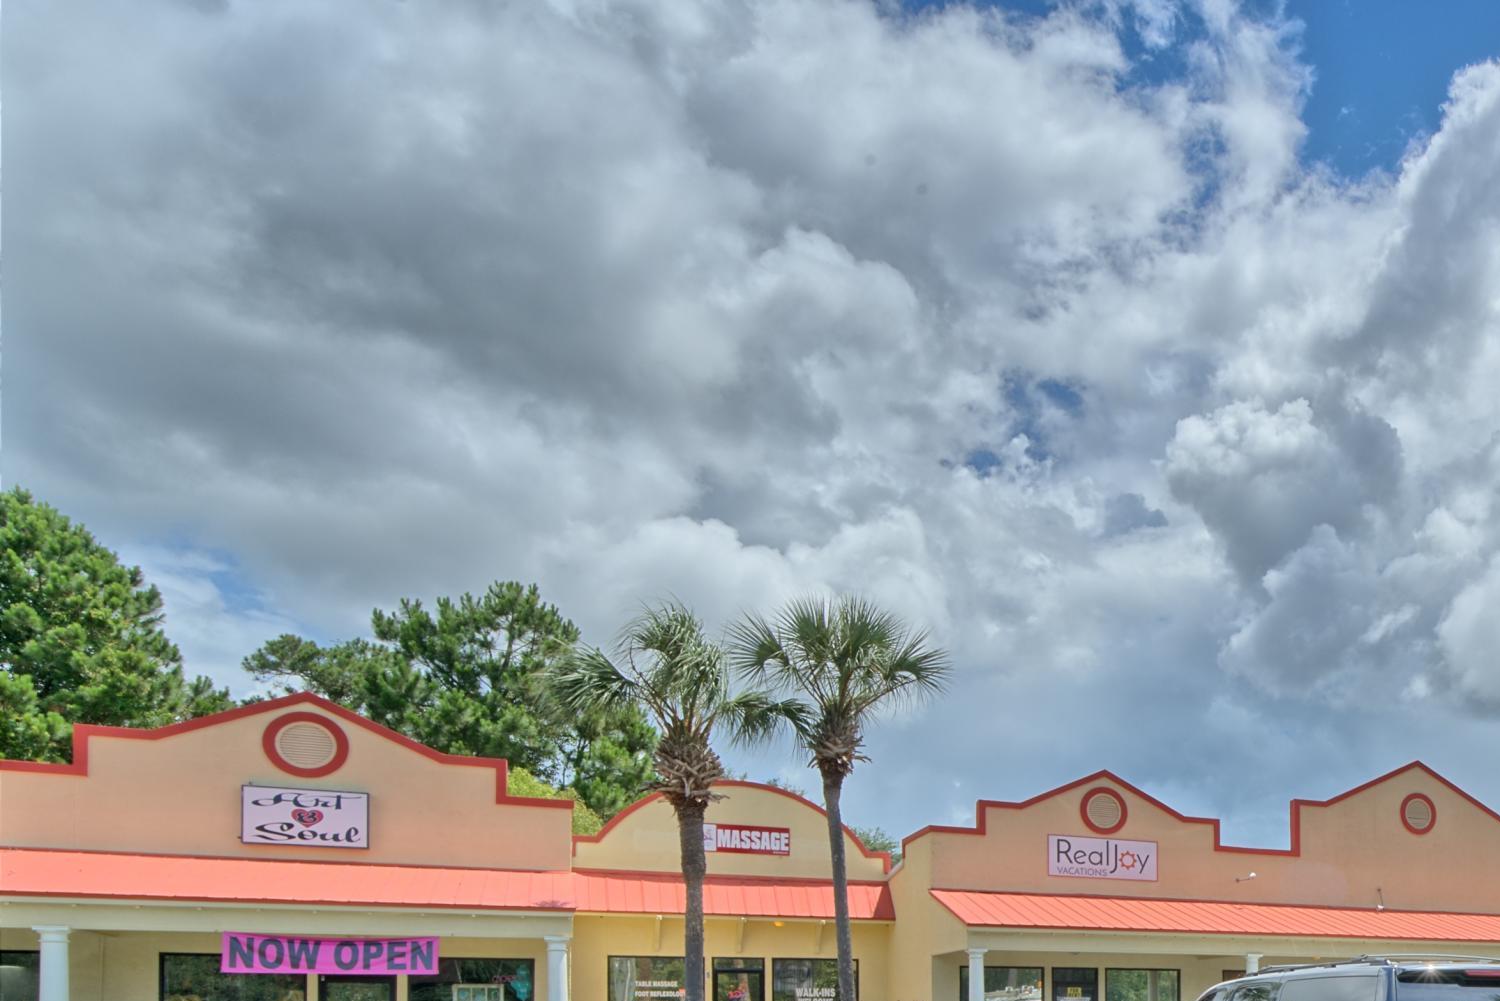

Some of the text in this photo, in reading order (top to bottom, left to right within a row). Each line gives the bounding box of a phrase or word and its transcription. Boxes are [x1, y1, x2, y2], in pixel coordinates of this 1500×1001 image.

[252, 821, 361, 843] Soul
[717, 829, 790, 852] MASSAGE
[1057, 866, 1108, 877] VACATIONS
[228, 936, 433, 971] NOW OPEN
[795, 988, 836, 998] WALK-INS
